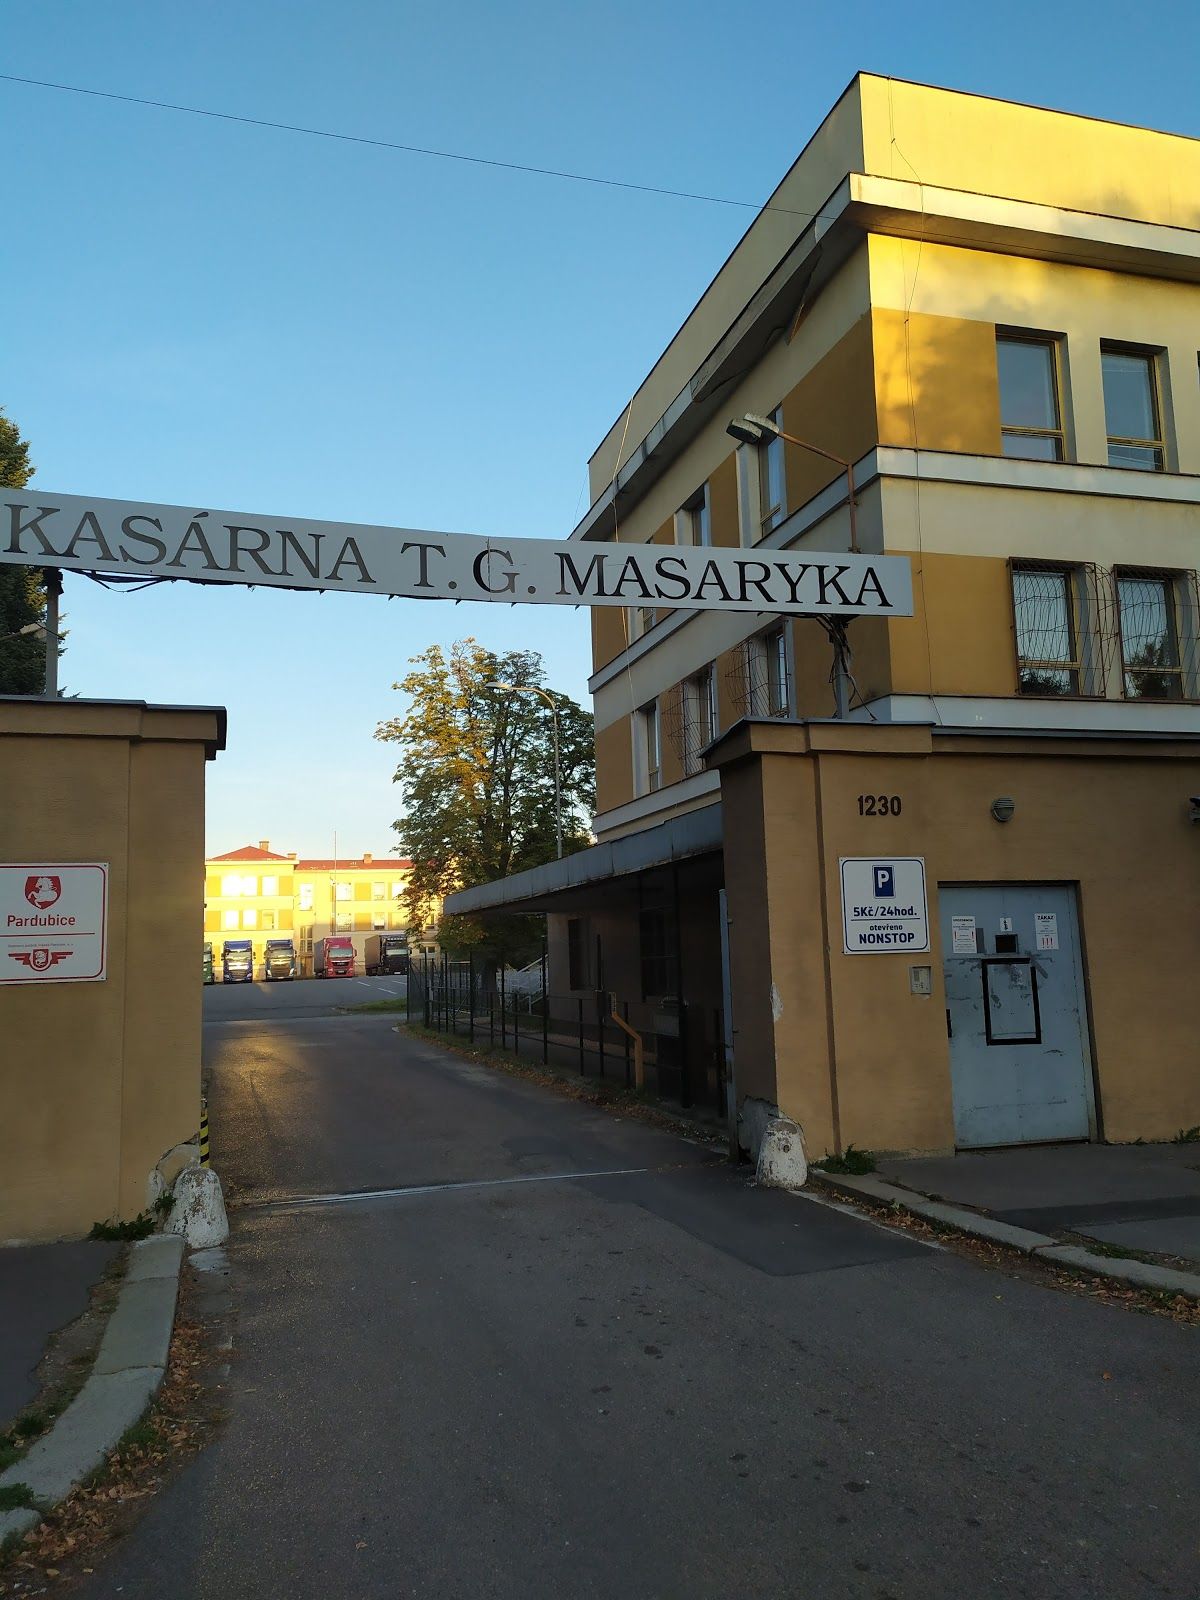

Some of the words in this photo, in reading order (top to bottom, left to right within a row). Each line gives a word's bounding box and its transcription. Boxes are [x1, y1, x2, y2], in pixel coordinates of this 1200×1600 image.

[2, 503, 377, 584] KASÁRNA
[400, 541, 458, 590] T.
[472, 548, 536, 595] G.
[554, 551, 894, 608] MASARYKA
[857, 795, 902, 817] 1230
[877, 870, 890, 889] P
[853, 905, 918, 917] 5Kč/24hod.
[7, 914, 76, 927] Pardubice
[869, 923, 903, 931] otevřeno
[859, 932, 915, 944] NONSTOP
